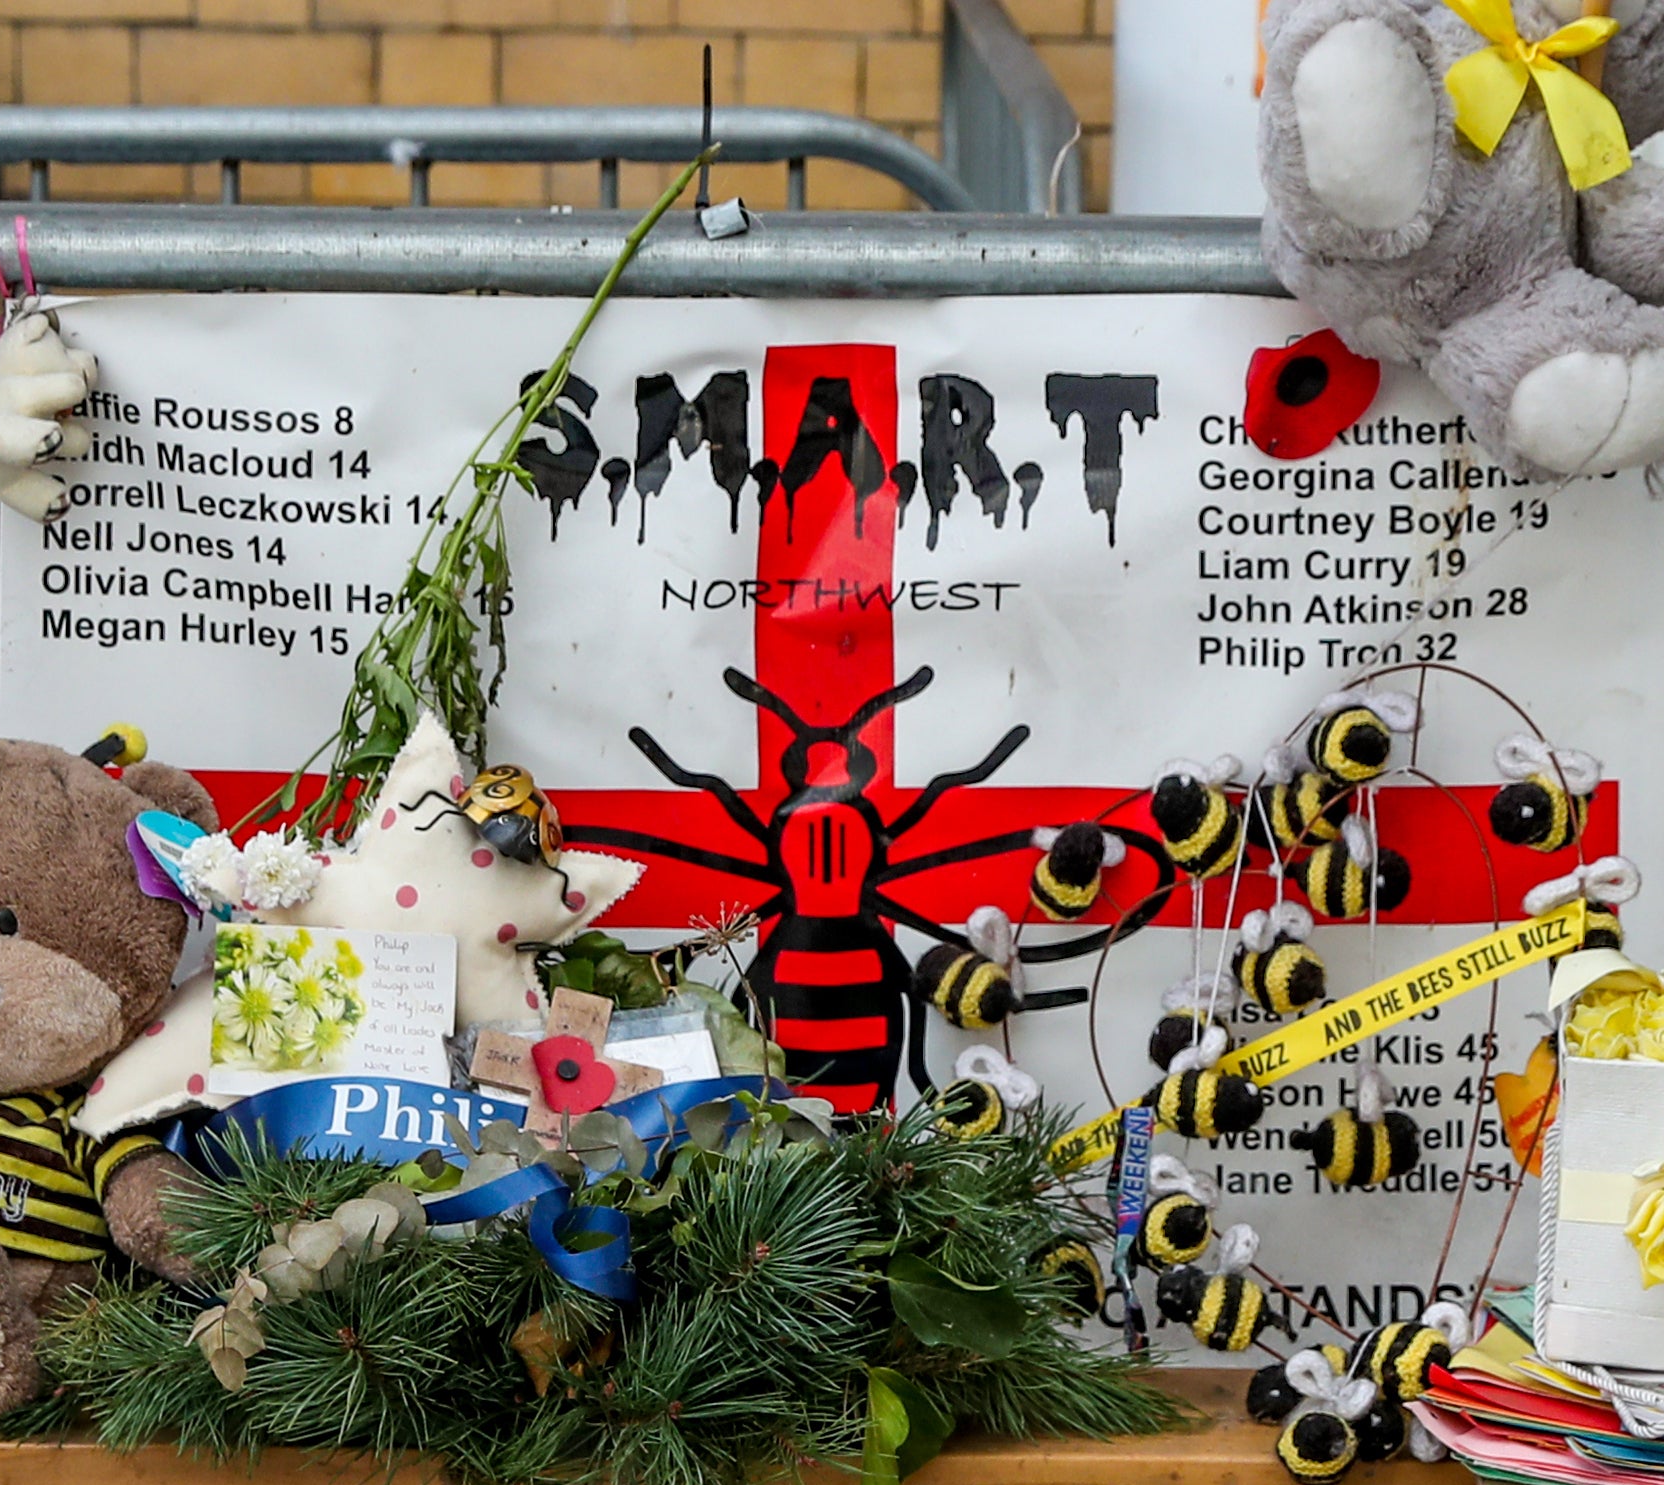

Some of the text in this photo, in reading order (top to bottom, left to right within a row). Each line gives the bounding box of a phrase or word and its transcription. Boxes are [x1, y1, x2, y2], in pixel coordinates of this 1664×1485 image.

[71, 391, 355, 435] affie Roussos 8
[156, 441, 372, 480] Macloud 14
[1198, 460, 1376, 498] Georgina
[176, 484, 391, 526] Leczkowski
[405, 495, 449, 527] 14
[1197, 498, 1549, 543] Courtney Boyle 19
[43, 520, 287, 566] Nell Jones 14
[1198, 548, 1467, 588] Liam Curry 19
[41, 563, 423, 616] Olivia Campbell Har
[662, 579, 1022, 612] NORTHWEST
[1197, 587, 1529, 625] John Atkinson 28
[41, 608, 349, 657] Megan Hurley 15
[1198, 633, 1458, 675] Philip Tron 32
[373, 935, 411, 954] Philip
[1323, 1008, 1364, 1047] AND
[1370, 988, 1403, 1022] THE
[1408, 966, 1454, 1006] BEES
[1455, 941, 1517, 982] STILL
[1519, 917, 1573, 955] BUZZ
[1374, 1034, 1445, 1065] Klis
[1456, 1033, 1500, 1063] 45
[1092, 1119, 1120, 1150] TH
